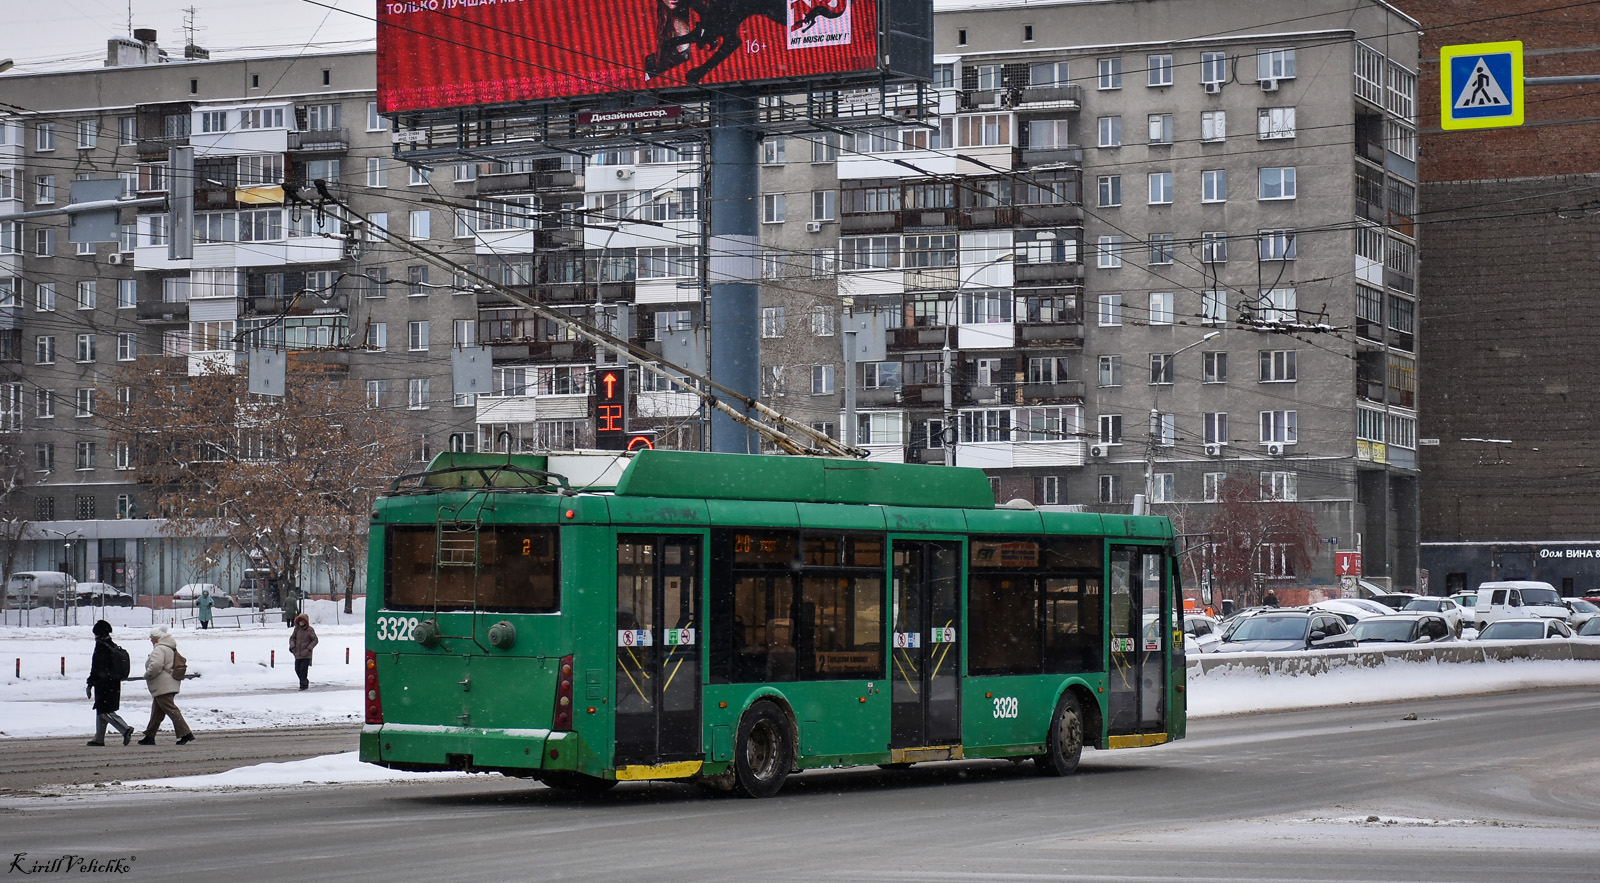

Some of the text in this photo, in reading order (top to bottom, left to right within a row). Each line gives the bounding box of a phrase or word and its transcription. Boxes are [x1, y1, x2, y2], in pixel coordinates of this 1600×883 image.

[386, 0, 439, 15] ТОЛЬКО
[745, 38, 767, 54] 16+
[790, 37, 802, 45] HIT
[803, 34, 825, 44] MUSIC
[826, 33, 843, 42] ONLY
[590, 109, 668, 123] Дизайнмастер.
[598, 405, 622, 431] 32
[522, 538, 531, 555] 2
[1540, 549, 1563, 558] Дом
[1566, 549, 1594, 558] ВИНА
[376, 616, 418, 641] 3328
[993, 696, 1019, 719] 3328
